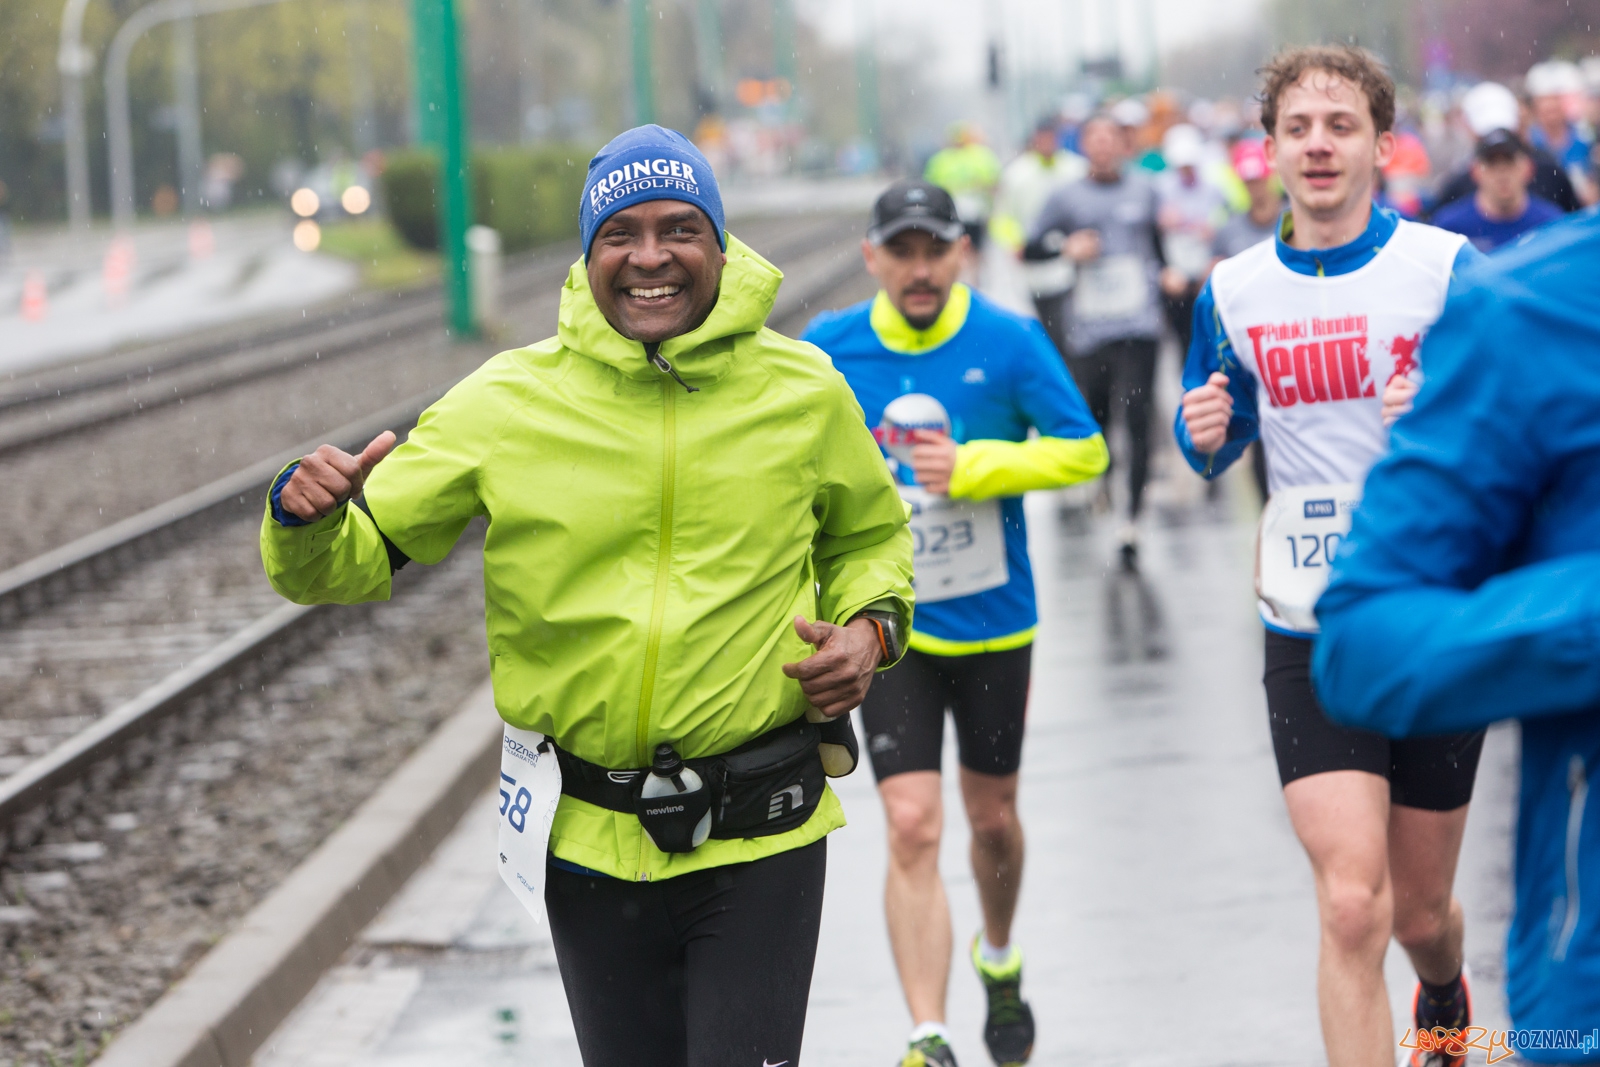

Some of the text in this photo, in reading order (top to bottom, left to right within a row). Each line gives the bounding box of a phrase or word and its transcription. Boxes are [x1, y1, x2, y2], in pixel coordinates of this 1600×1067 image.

[590, 158, 697, 207] ERDINGER
[592, 178, 700, 219] ALKOHOLFREI
[1312, 314, 1368, 337] Running
[646, 804, 684, 816] newline
